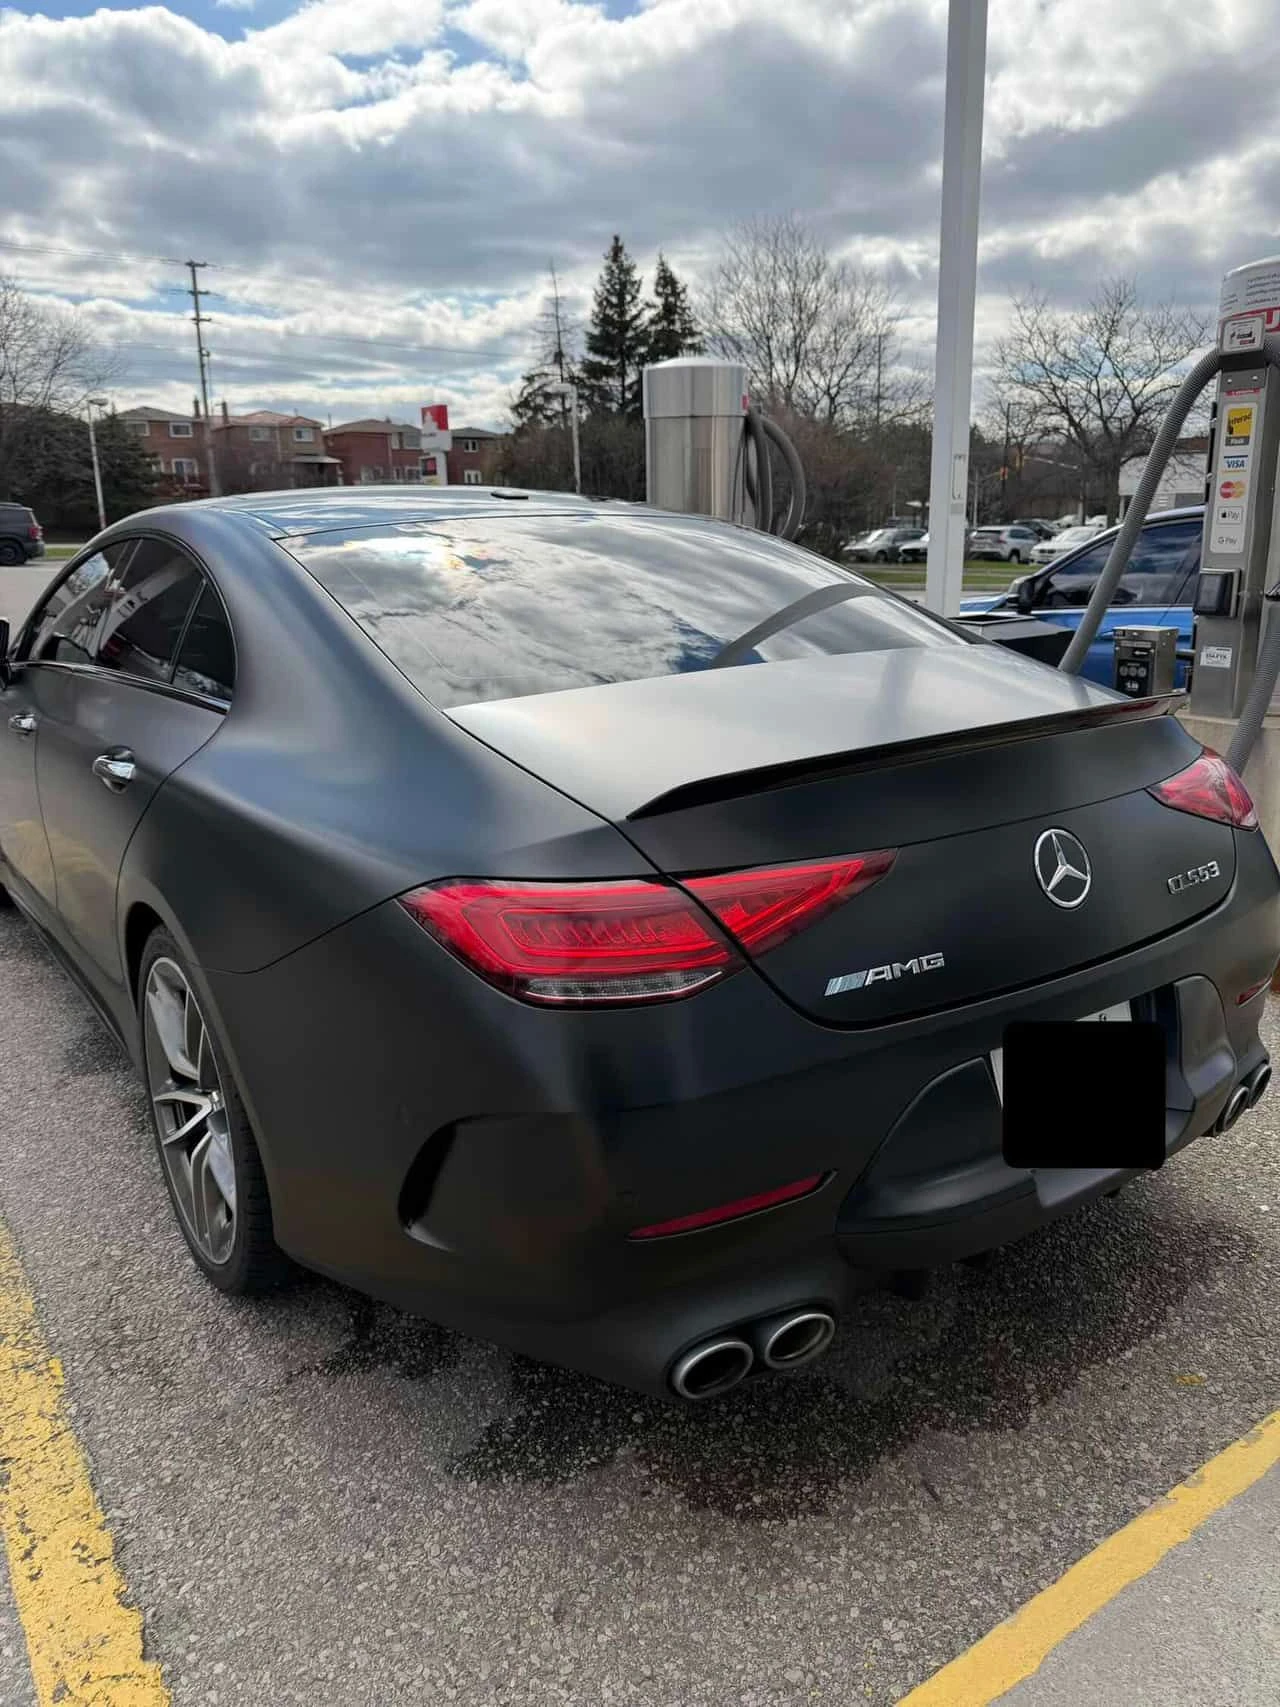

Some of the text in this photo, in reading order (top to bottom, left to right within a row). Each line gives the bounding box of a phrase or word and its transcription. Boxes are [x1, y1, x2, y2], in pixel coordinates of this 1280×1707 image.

[1226, 459, 1246, 469] VISA
[1228, 510, 1240, 520] Pay
[864, 952, 945, 986] AMG
